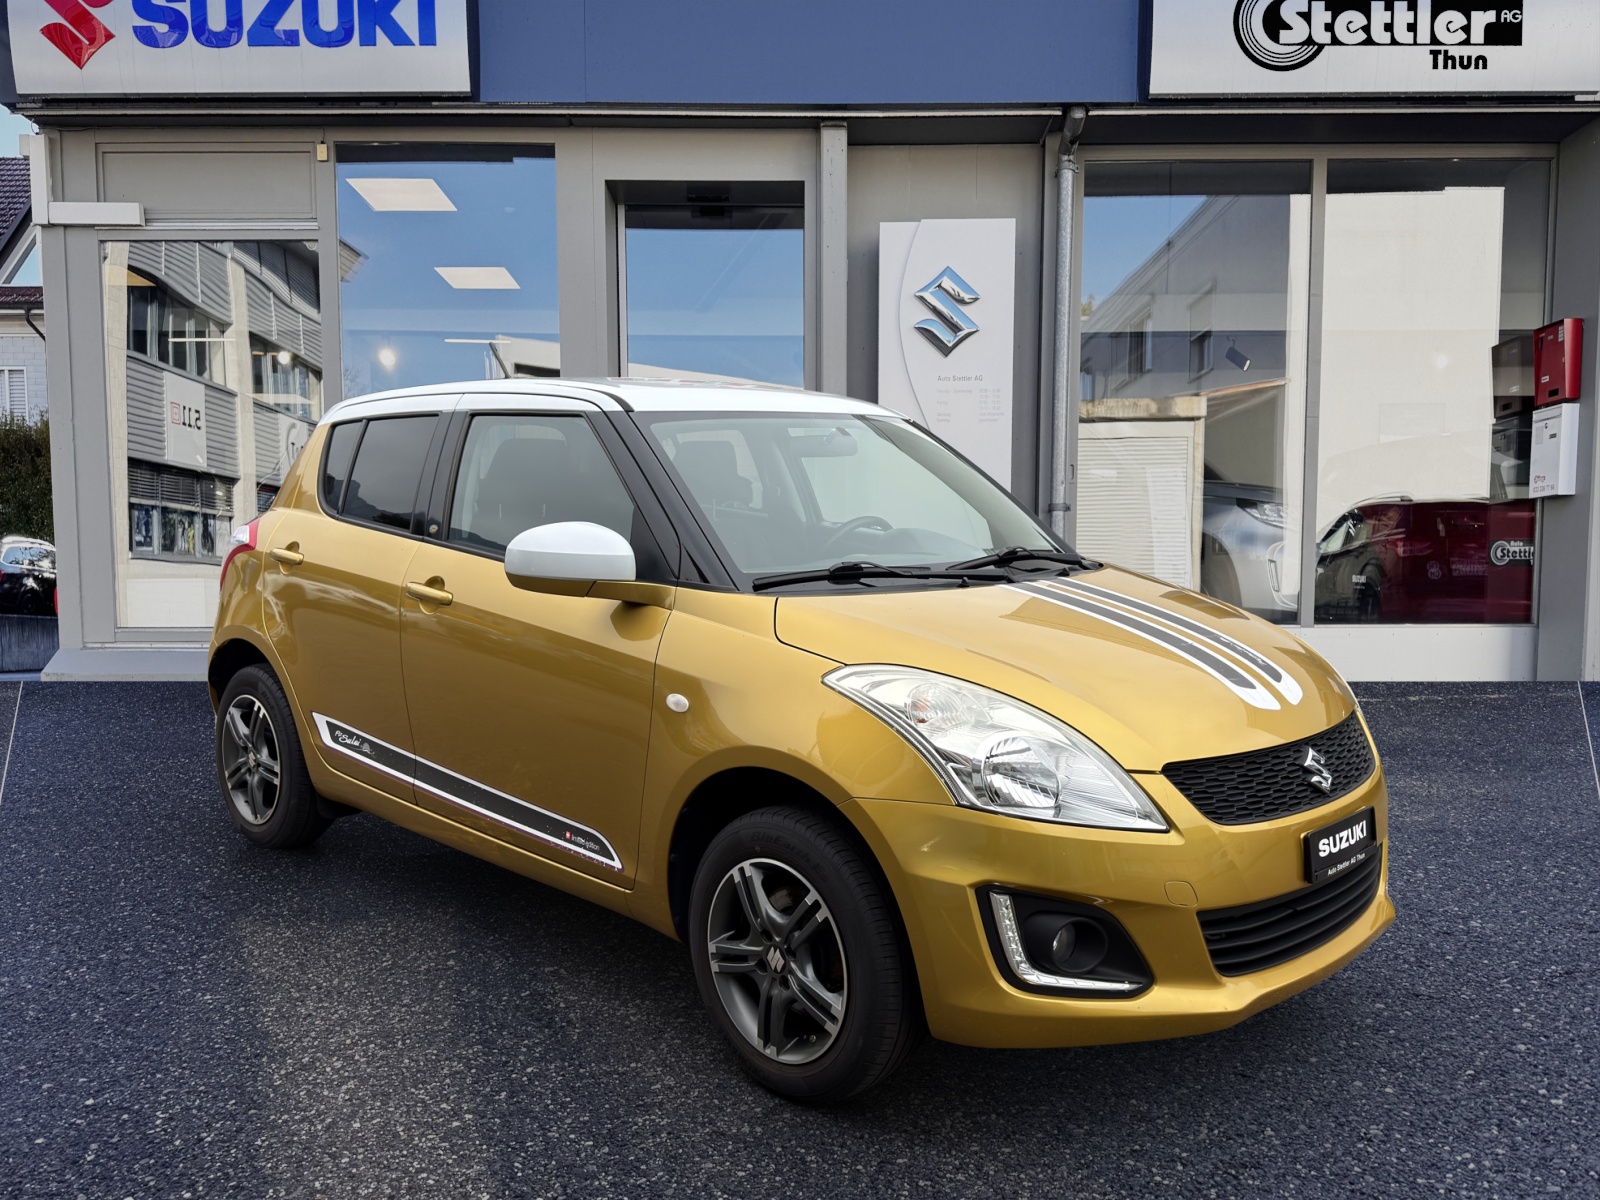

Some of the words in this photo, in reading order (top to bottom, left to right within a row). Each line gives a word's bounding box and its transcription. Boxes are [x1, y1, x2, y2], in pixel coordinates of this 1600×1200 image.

[132, 0, 437, 48] SUZUKI
[1279, 0, 1497, 45] Stettler
[1501, 10, 1522, 23] AG
[1429, 50, 1488, 70] Thun
[1500, 547, 1534, 559] Stettl
[1318, 820, 1367, 857] SUZUKI
[1328, 867, 1337, 875] Auto
